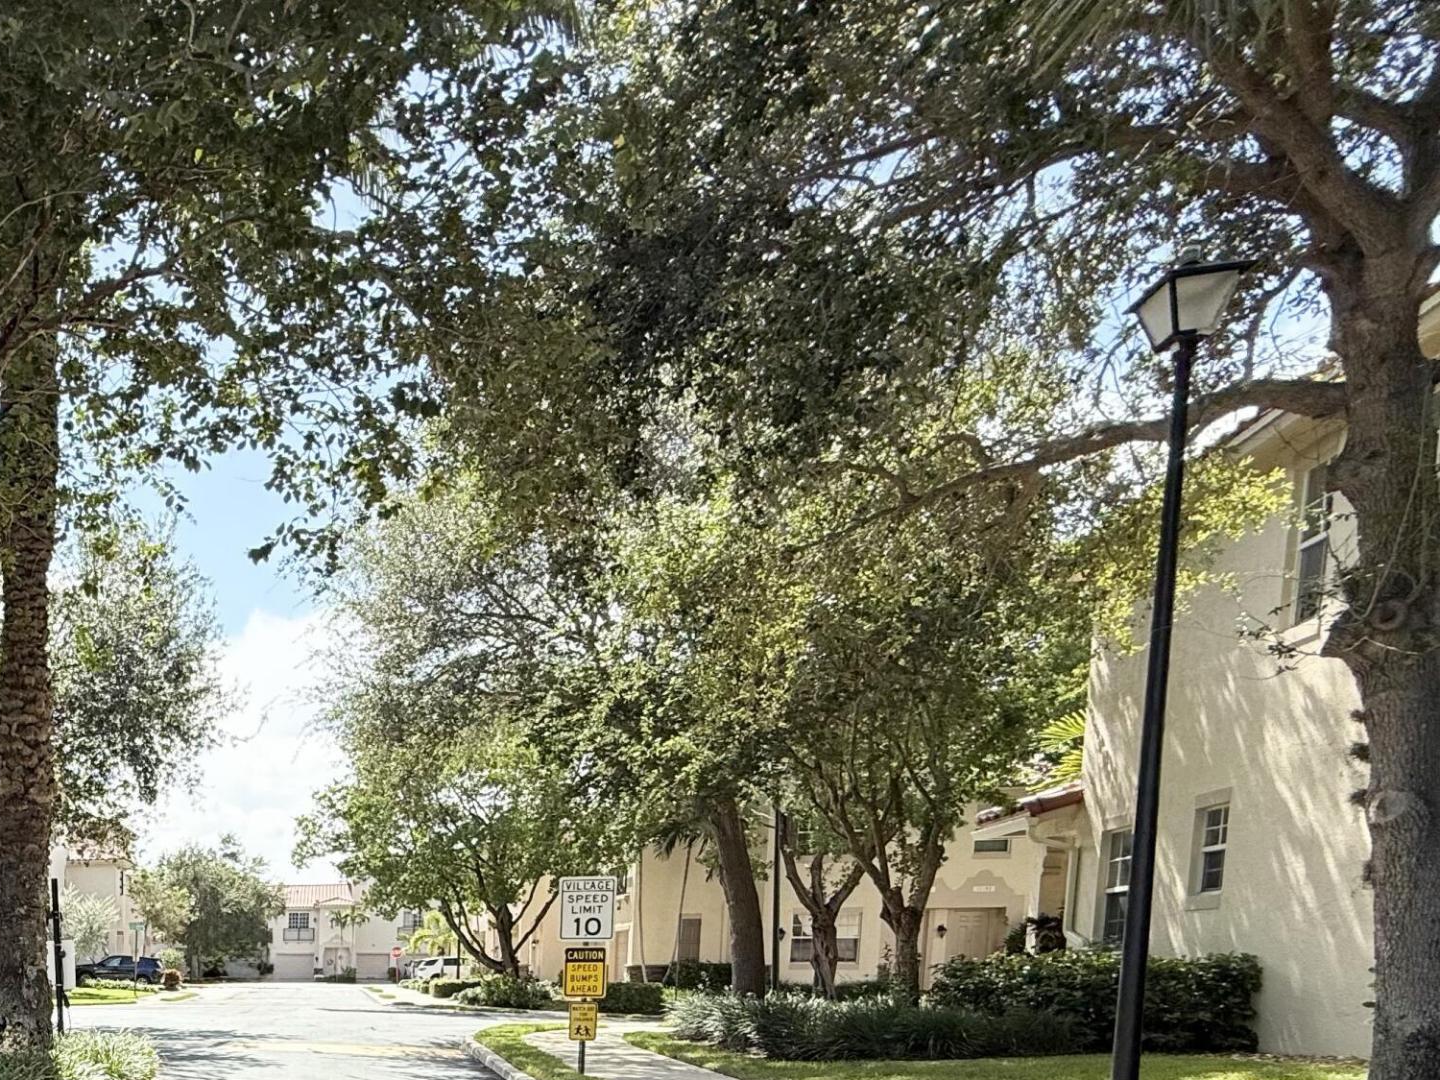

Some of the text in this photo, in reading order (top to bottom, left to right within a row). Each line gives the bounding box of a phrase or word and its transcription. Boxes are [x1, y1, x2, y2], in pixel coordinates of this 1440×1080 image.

[565, 880, 612, 891] VILLAGE
[568, 894, 609, 904] SPEED
[571, 905, 603, 915] LIMIT
[573, 917, 602, 936] 10
[567, 950, 604, 960] CAUTION
[571, 964, 598, 973] SPEED
[570, 974, 599, 983] BUMPS
[570, 984, 598, 993] AHEAD
